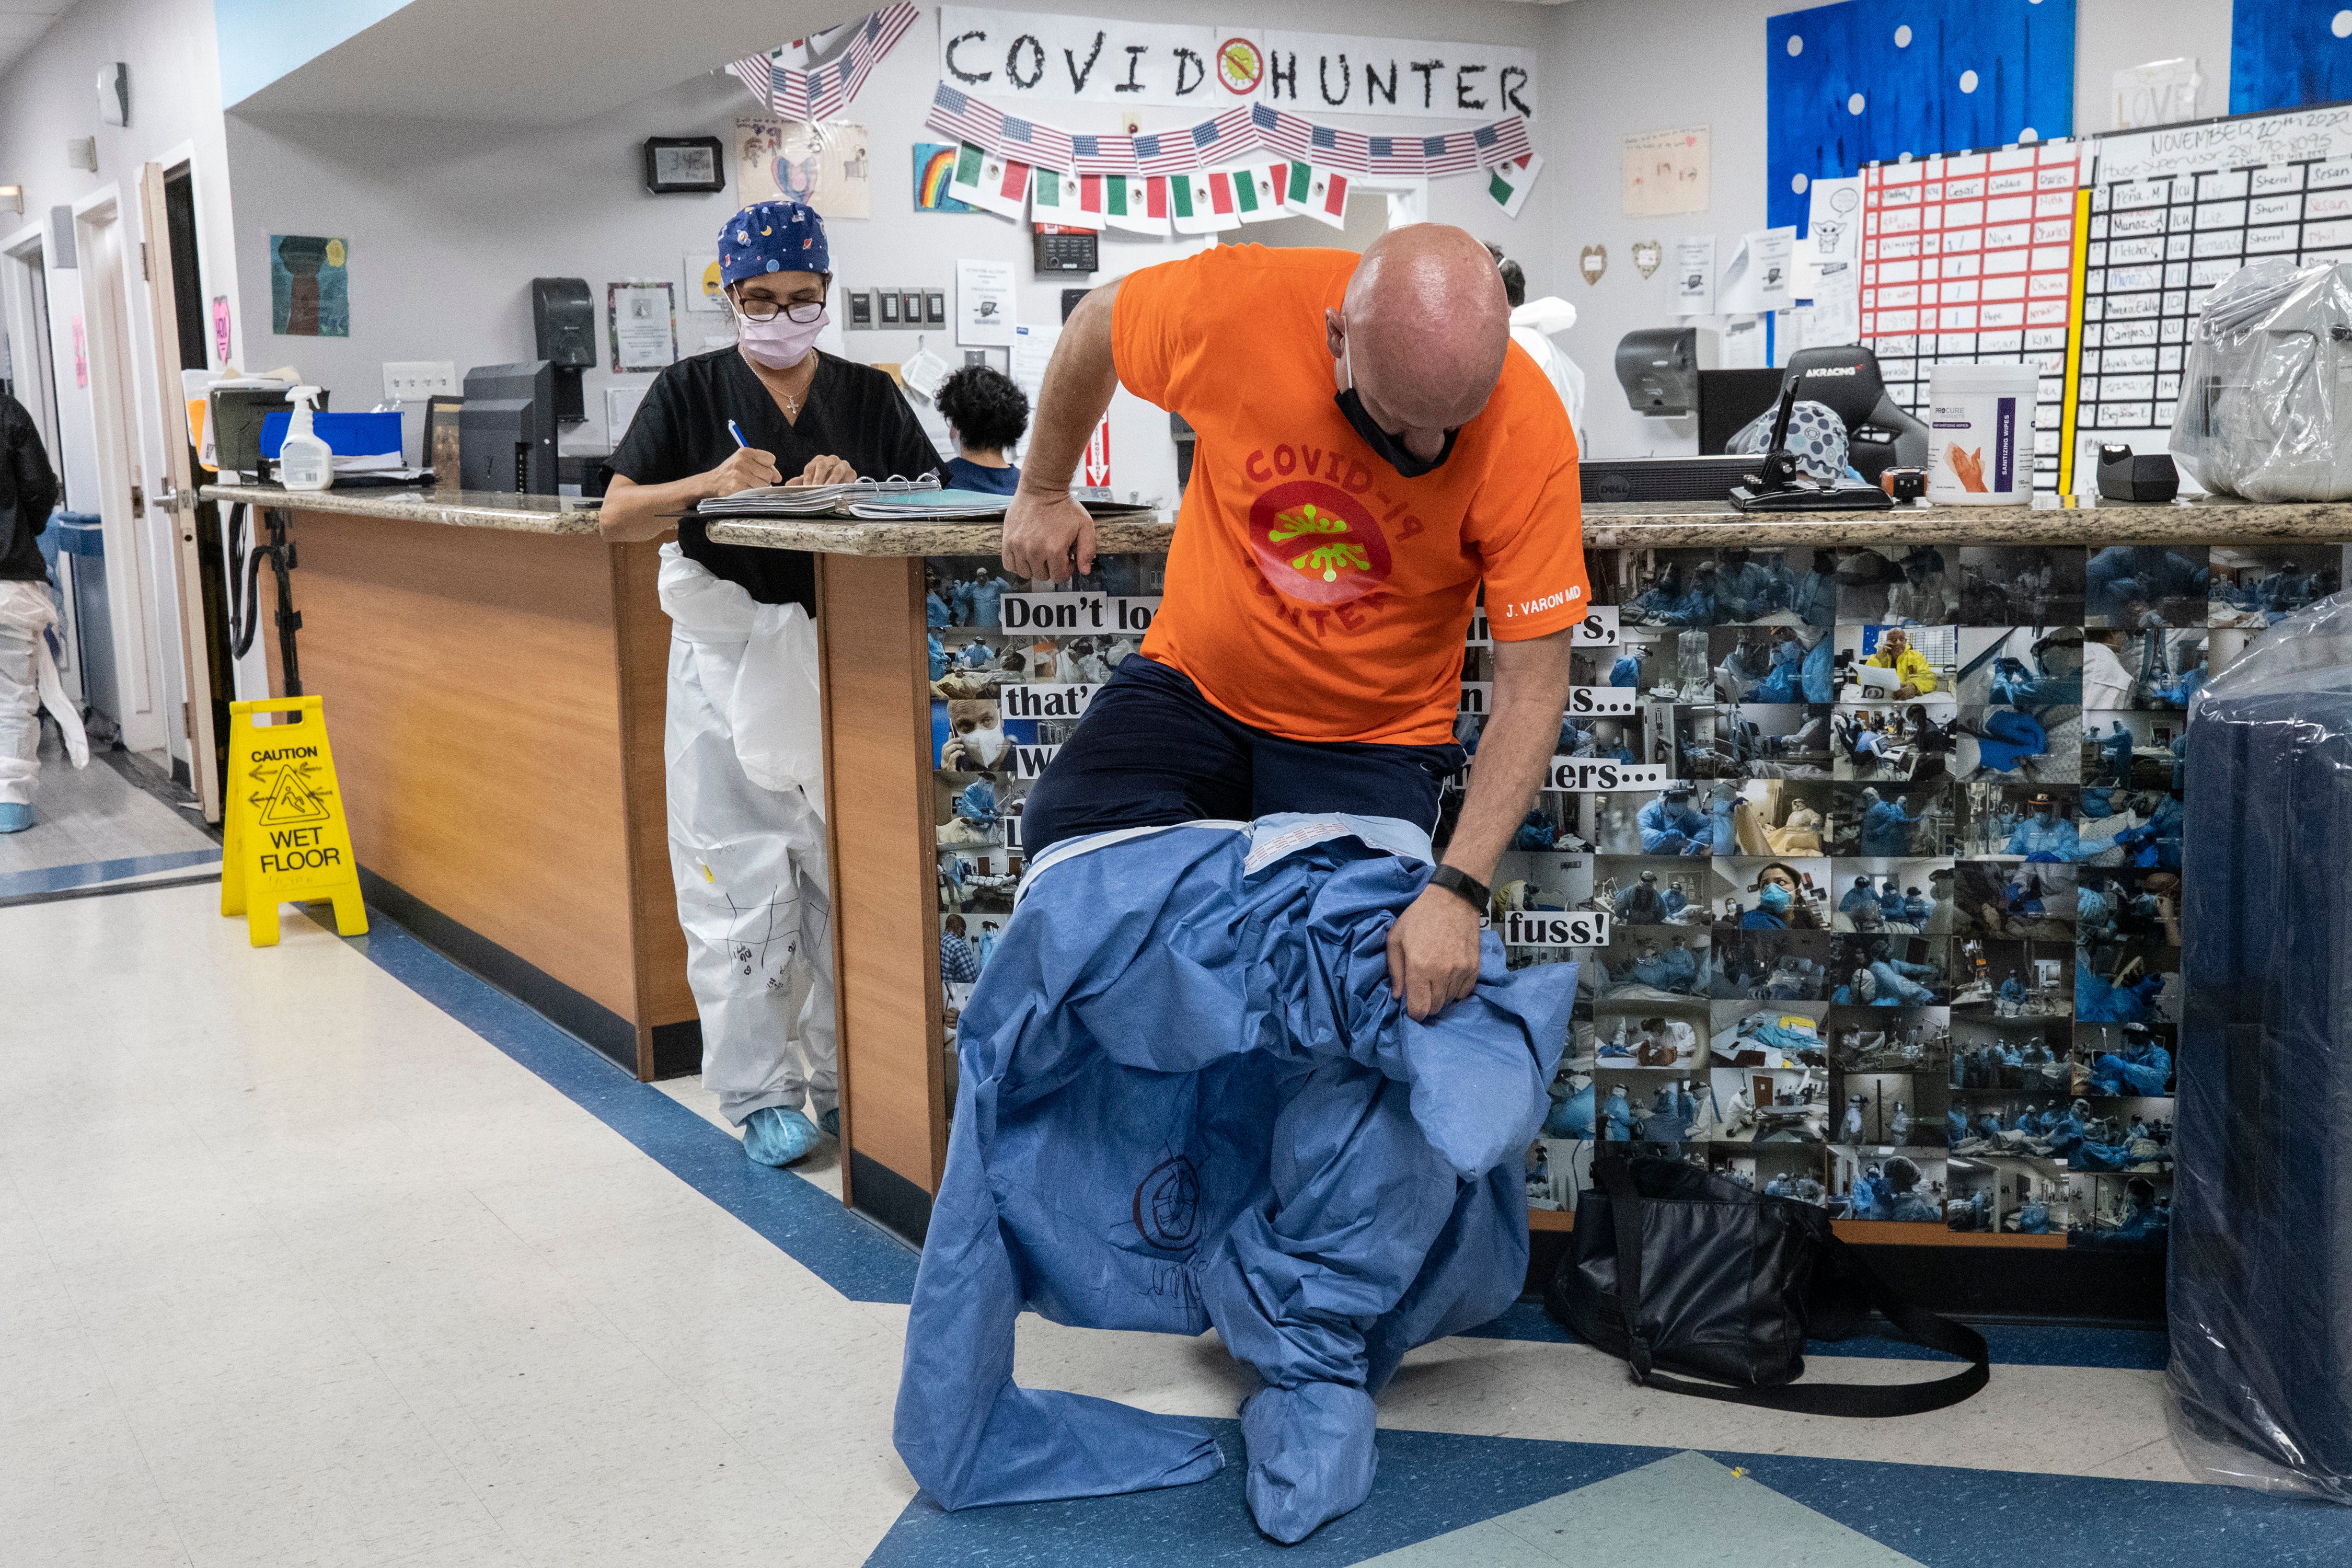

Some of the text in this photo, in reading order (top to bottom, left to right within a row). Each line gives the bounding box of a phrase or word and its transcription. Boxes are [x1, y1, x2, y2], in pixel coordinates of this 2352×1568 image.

[946, 30, 1531, 118] COVID HUNTER
[2151, 121, 2254, 156] NOVEMBER
[2164, 321, 2180, 336] ICU
[1805, 367, 1855, 377] AKRACING
[1245, 443, 1425, 543] COVID-19
[1005, 597, 1158, 630] Don't lo
[1506, 585, 1582, 618] J. VARON MD
[1006, 685, 1088, 716] that'
[251, 746, 318, 762] CAUTION
[270, 826, 322, 849] WET
[260, 848, 341, 873] FLOOR
[1507, 912, 1605, 944] fuss!
